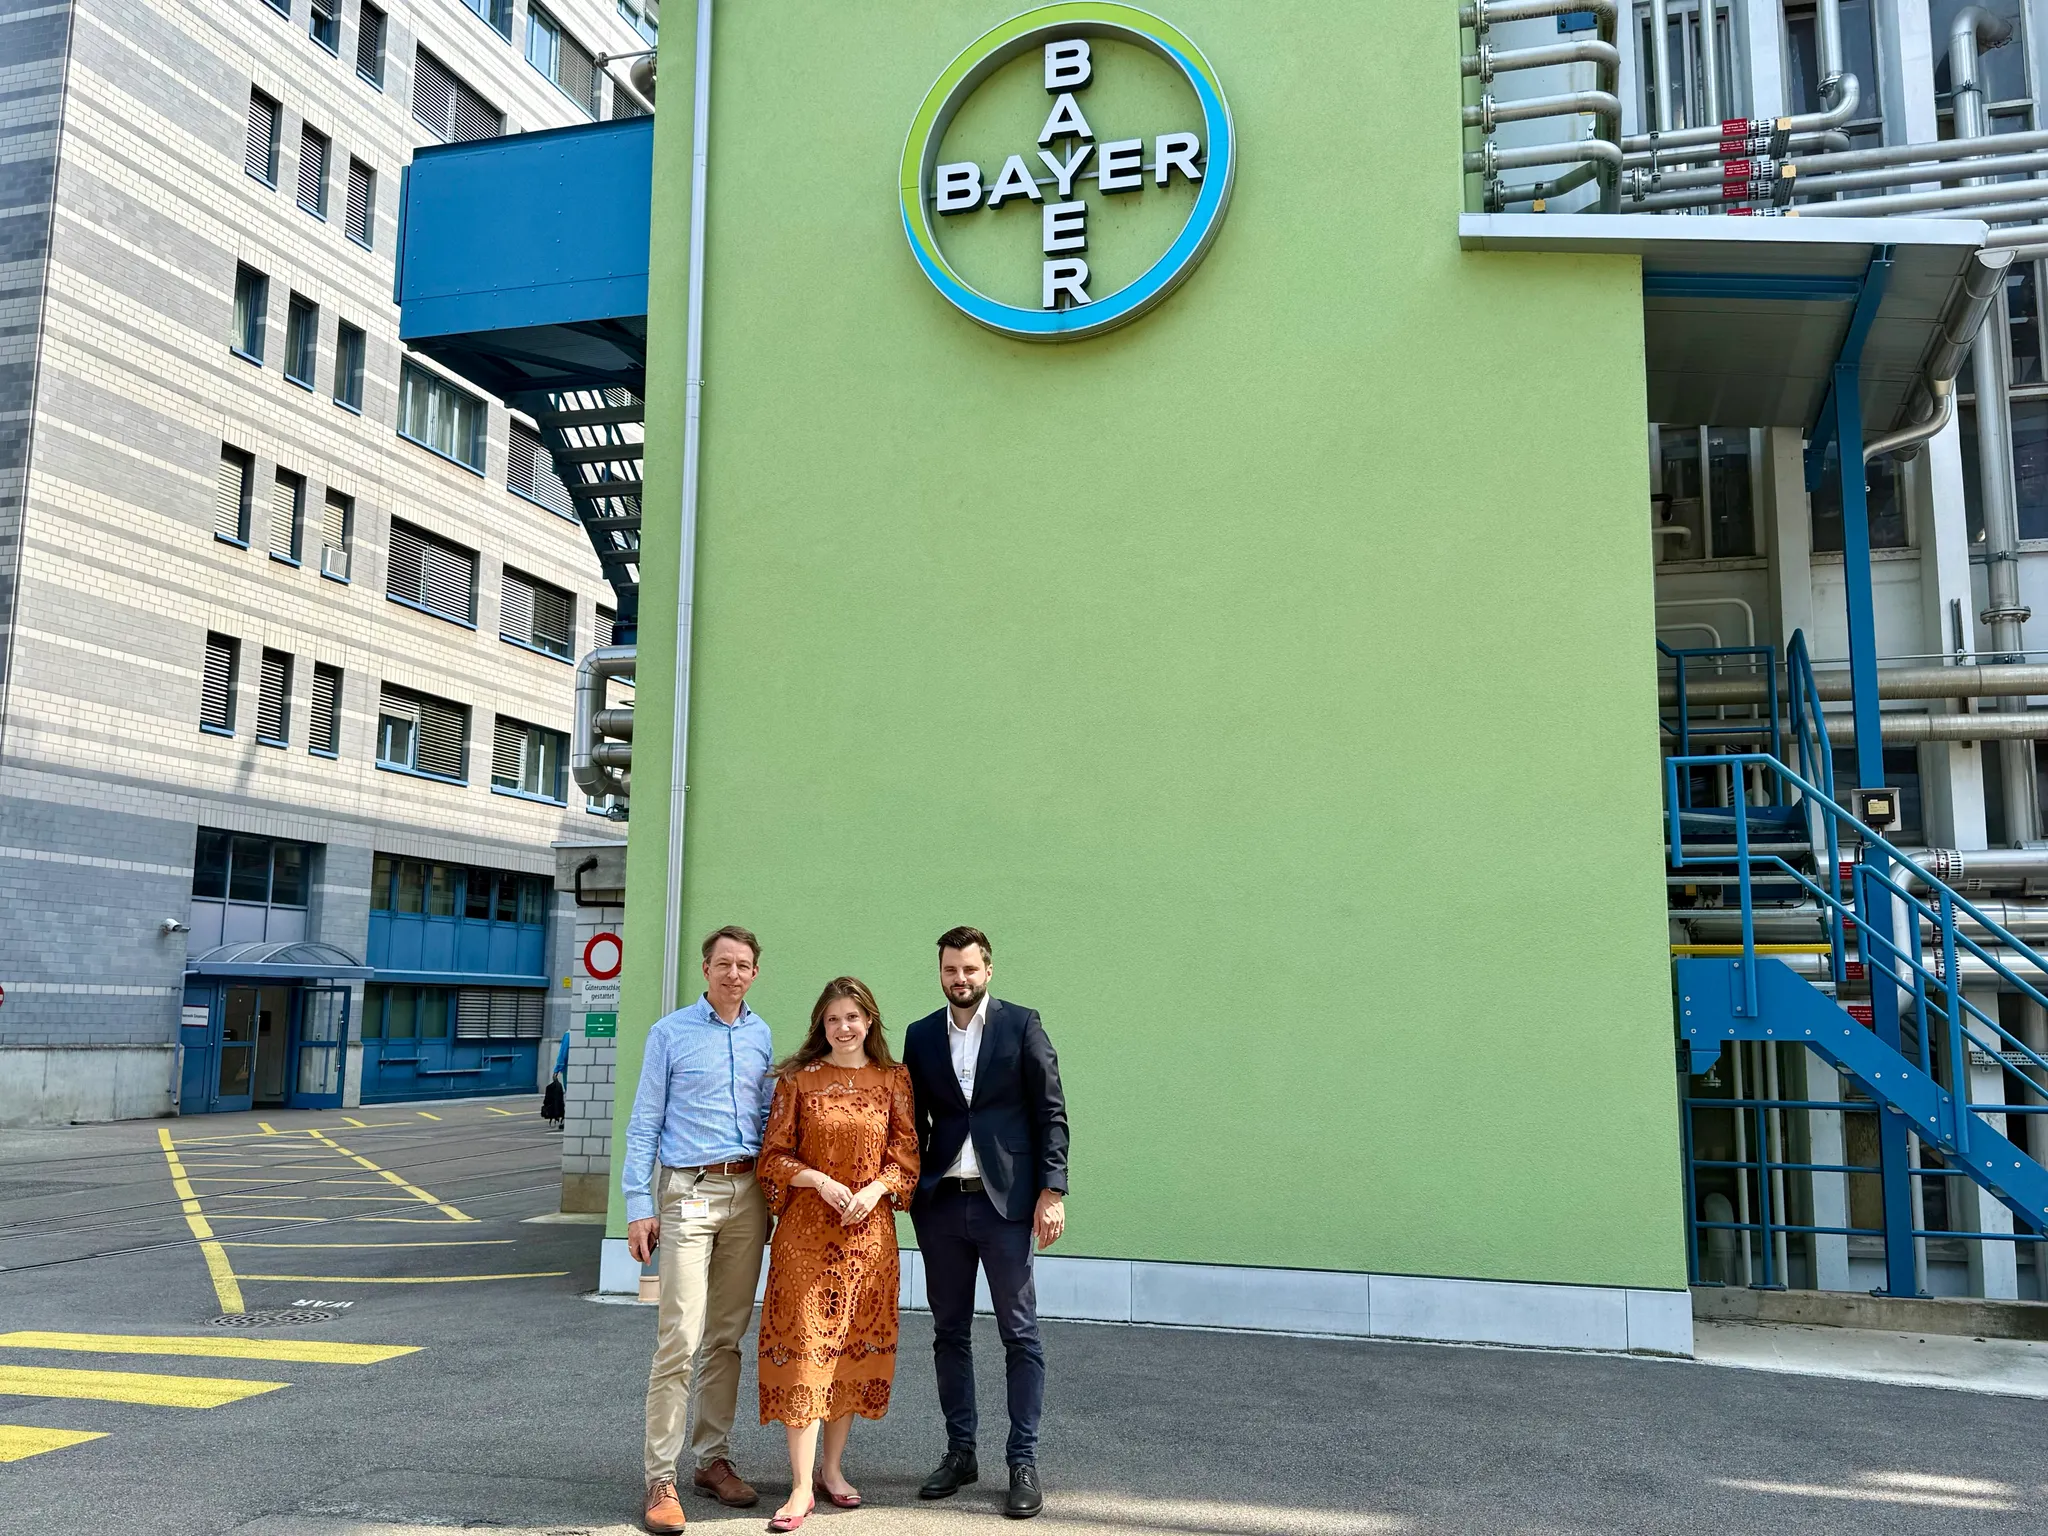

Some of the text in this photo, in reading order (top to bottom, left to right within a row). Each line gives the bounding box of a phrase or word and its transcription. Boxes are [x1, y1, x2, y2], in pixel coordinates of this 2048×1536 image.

[936, 132, 1203, 215] BAYER
[1037, 39, 1096, 309] BAYER
[591, 993, 614, 1001] gestattet
